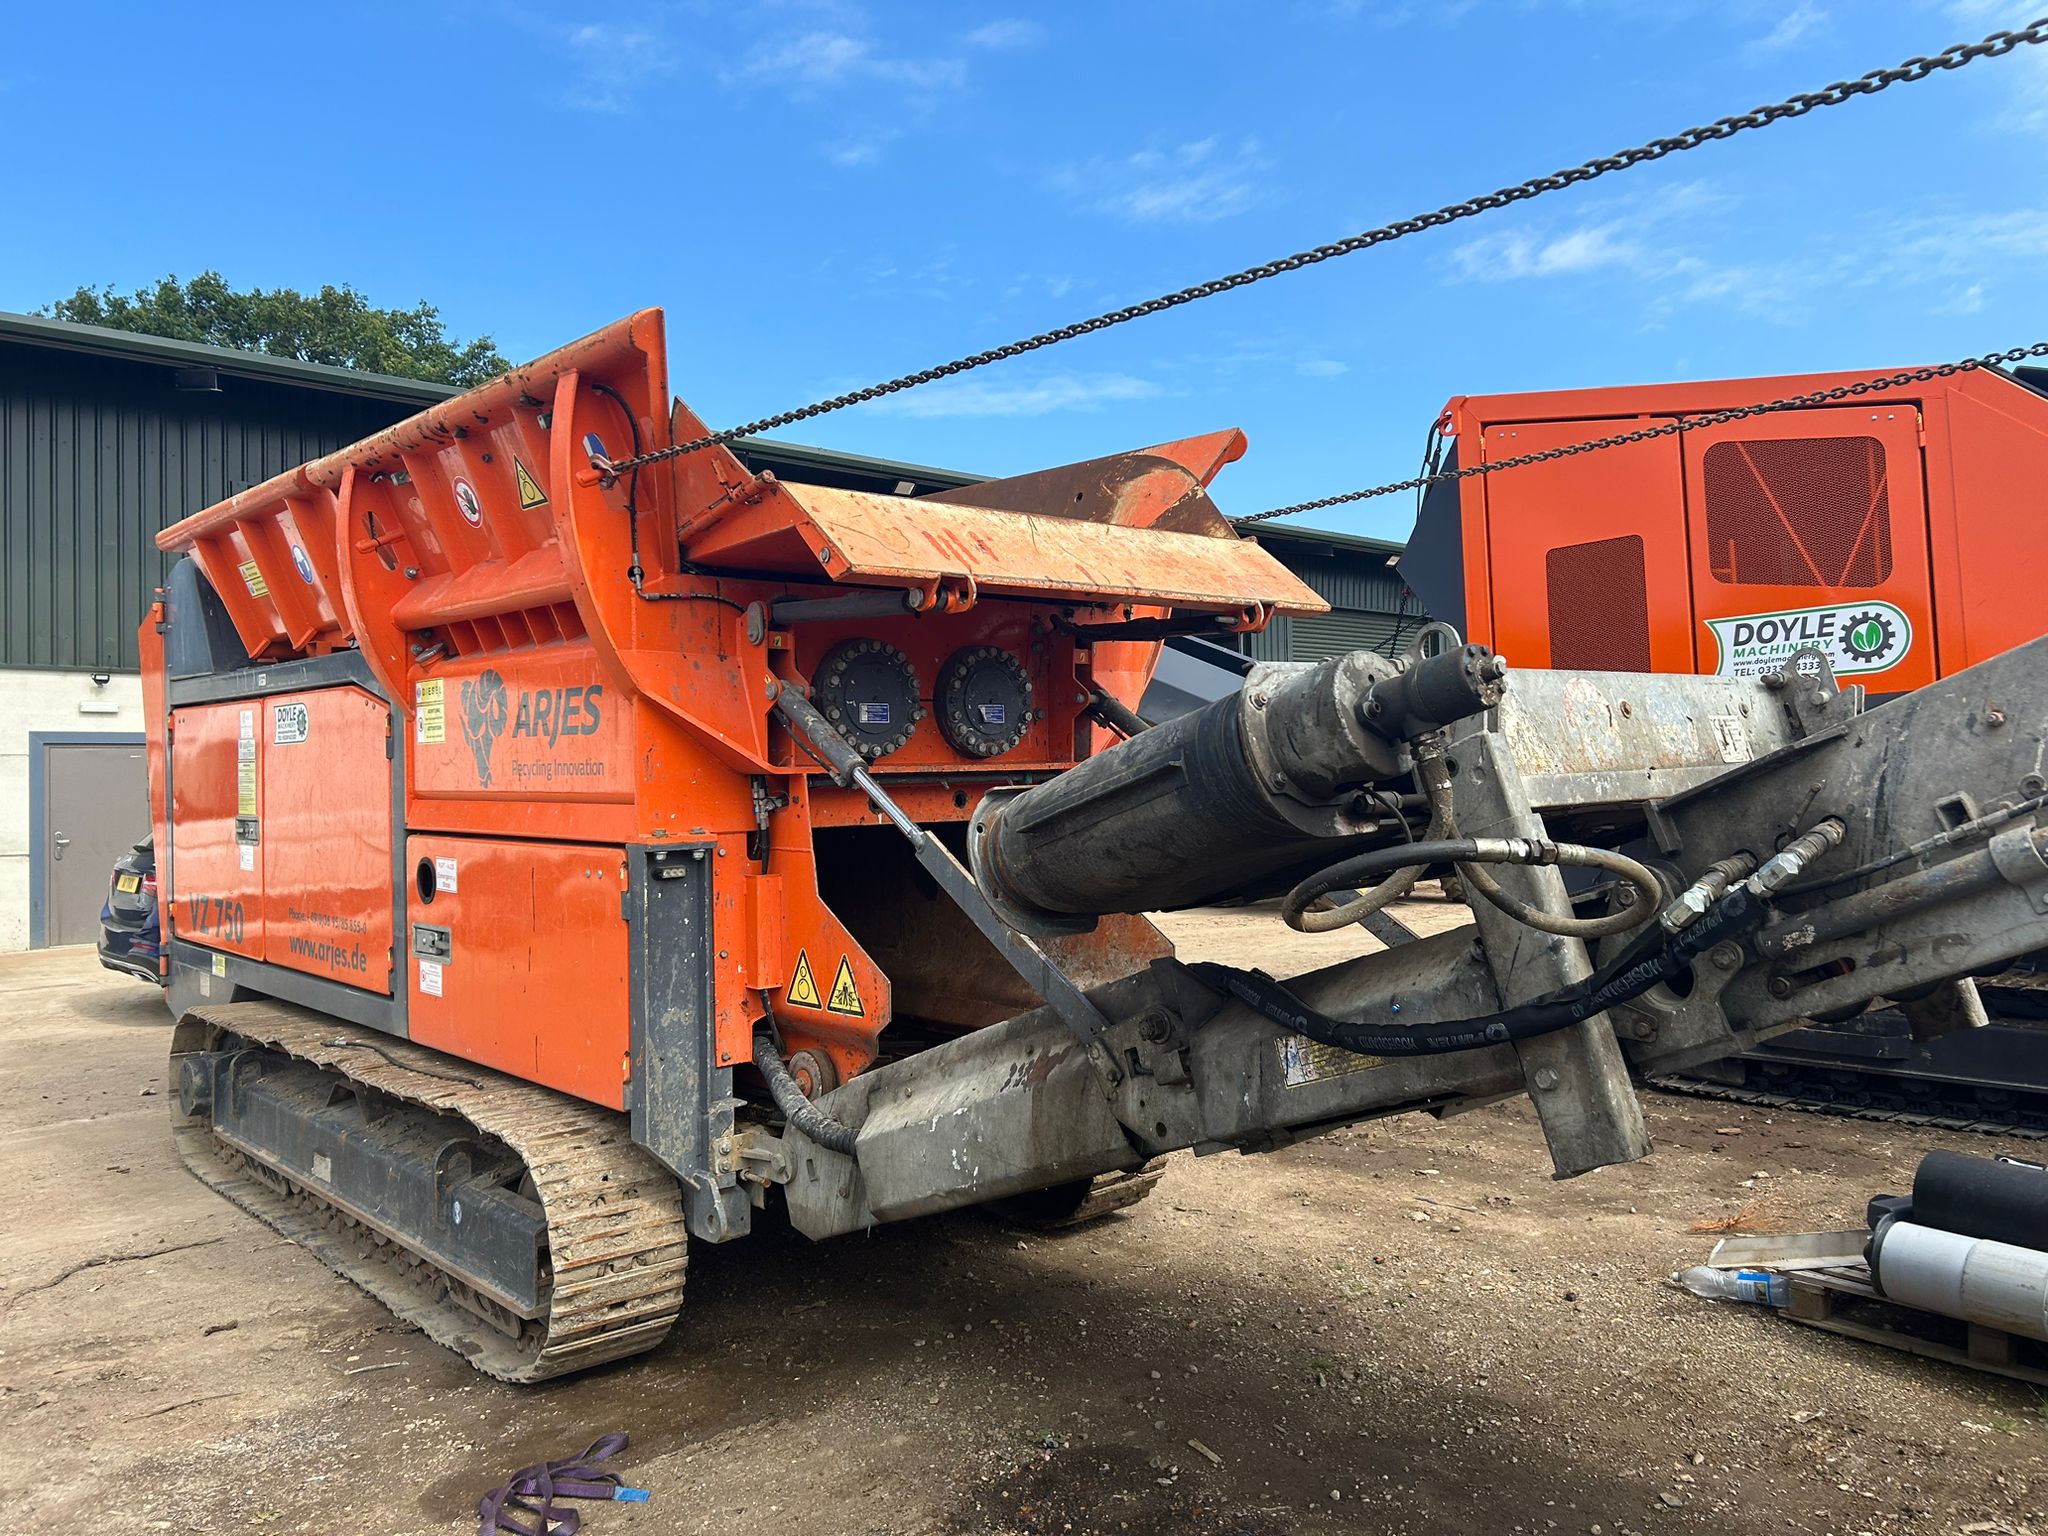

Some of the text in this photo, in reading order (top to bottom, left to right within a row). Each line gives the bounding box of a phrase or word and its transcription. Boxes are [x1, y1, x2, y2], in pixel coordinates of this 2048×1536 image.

[1733, 613, 1836, 646] DOYLE
[1733, 639, 1833, 658] MACHINERY
[1734, 668, 1755, 676] TEL:
[278, 707, 296, 722] DOYLE
[512, 685, 603, 749] ARJES
[512, 760, 604, 780] Recycling Innovation
[189, 892, 244, 944] VZ 750
[289, 936, 367, 972] www.arjes.de
